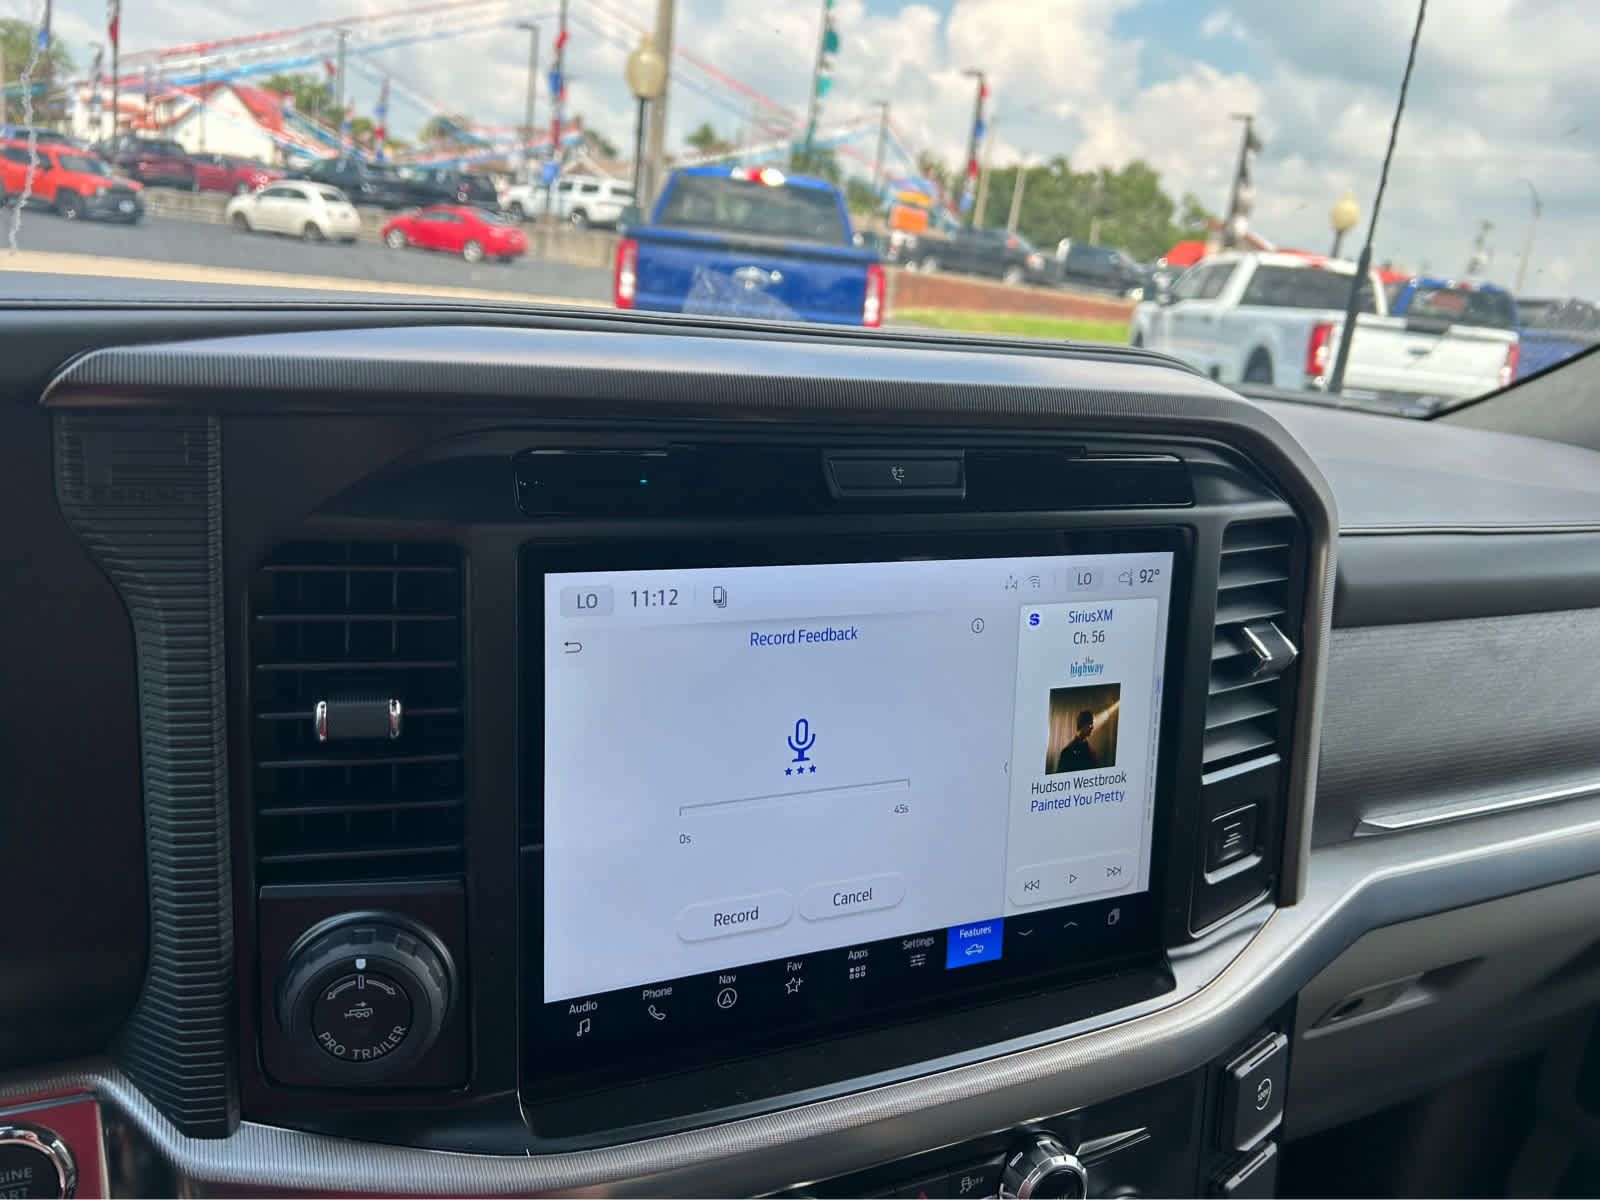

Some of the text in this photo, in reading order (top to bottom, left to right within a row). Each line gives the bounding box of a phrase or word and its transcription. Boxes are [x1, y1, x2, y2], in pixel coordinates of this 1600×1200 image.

[1077, 572, 1092, 586] LO
[1138, 568, 1160, 584] 92°
[576, 593, 598, 610] LO
[630, 588, 679, 608] 11:12
[1068, 608, 1113, 624] SiriusXM
[750, 625, 858, 647] Record Feedback
[1073, 630, 1105, 646] Ch. 56
[1070, 661, 1104, 677] highway
[1031, 771, 1127, 795] Hudson Westbrook
[1030, 790, 1126, 812] Painted You Pretty
[894, 804, 910, 815] 45s
[679, 833, 692, 845] 0s
[833, 888, 873, 906] Cancel
[713, 906, 760, 927] Record
[959, 924, 992, 939] Features
[902, 936, 935, 950] Settings
[848, 949, 869, 961] Apps
[786, 961, 803, 973] Fav
[718, 974, 738, 985] Nav
[642, 986, 673, 1000] Phone
[568, 1000, 598, 1015] Audio
[318, 1025, 407, 1061] PRO TRAILER
